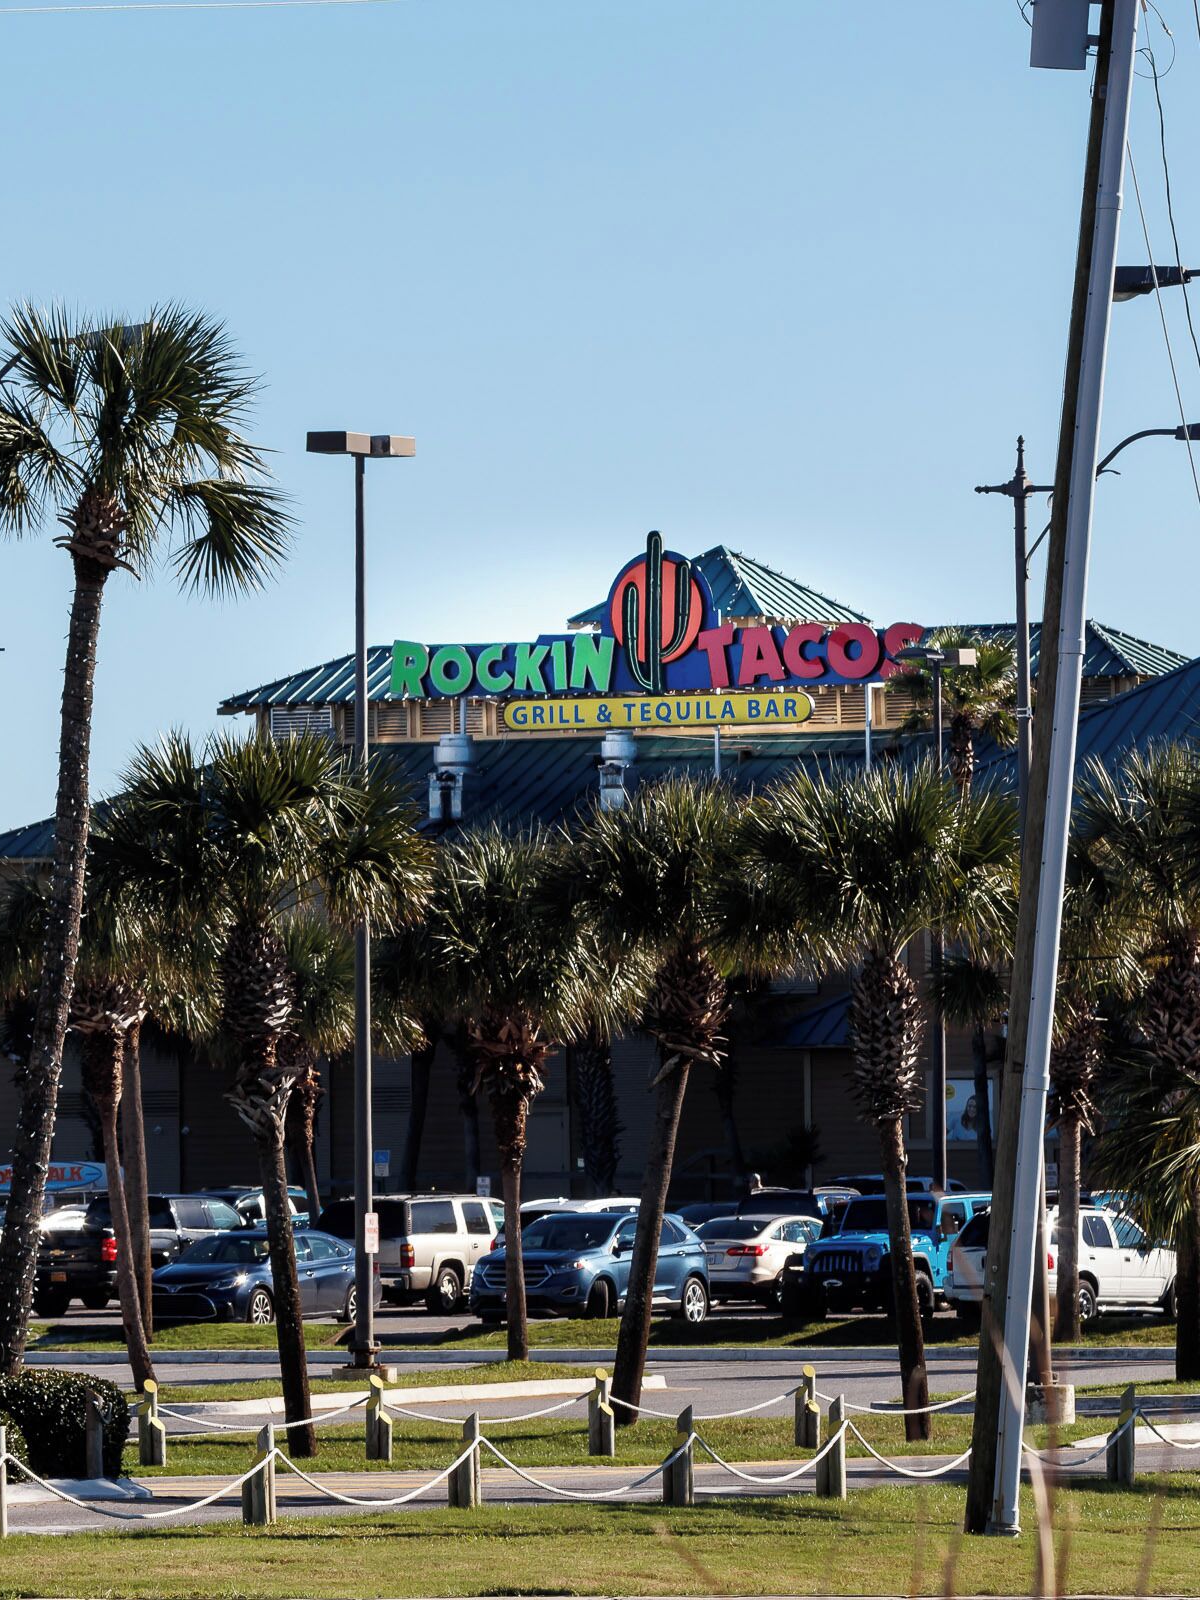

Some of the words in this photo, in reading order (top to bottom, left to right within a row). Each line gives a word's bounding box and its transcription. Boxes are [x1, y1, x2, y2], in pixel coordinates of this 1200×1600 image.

[389, 632, 615, 697] ROCKIN
[511, 704, 585, 725] GRILL
[596, 703, 612, 723] &
[623, 700, 736, 724] TEQUILA
[747, 698, 798, 719] BAR
